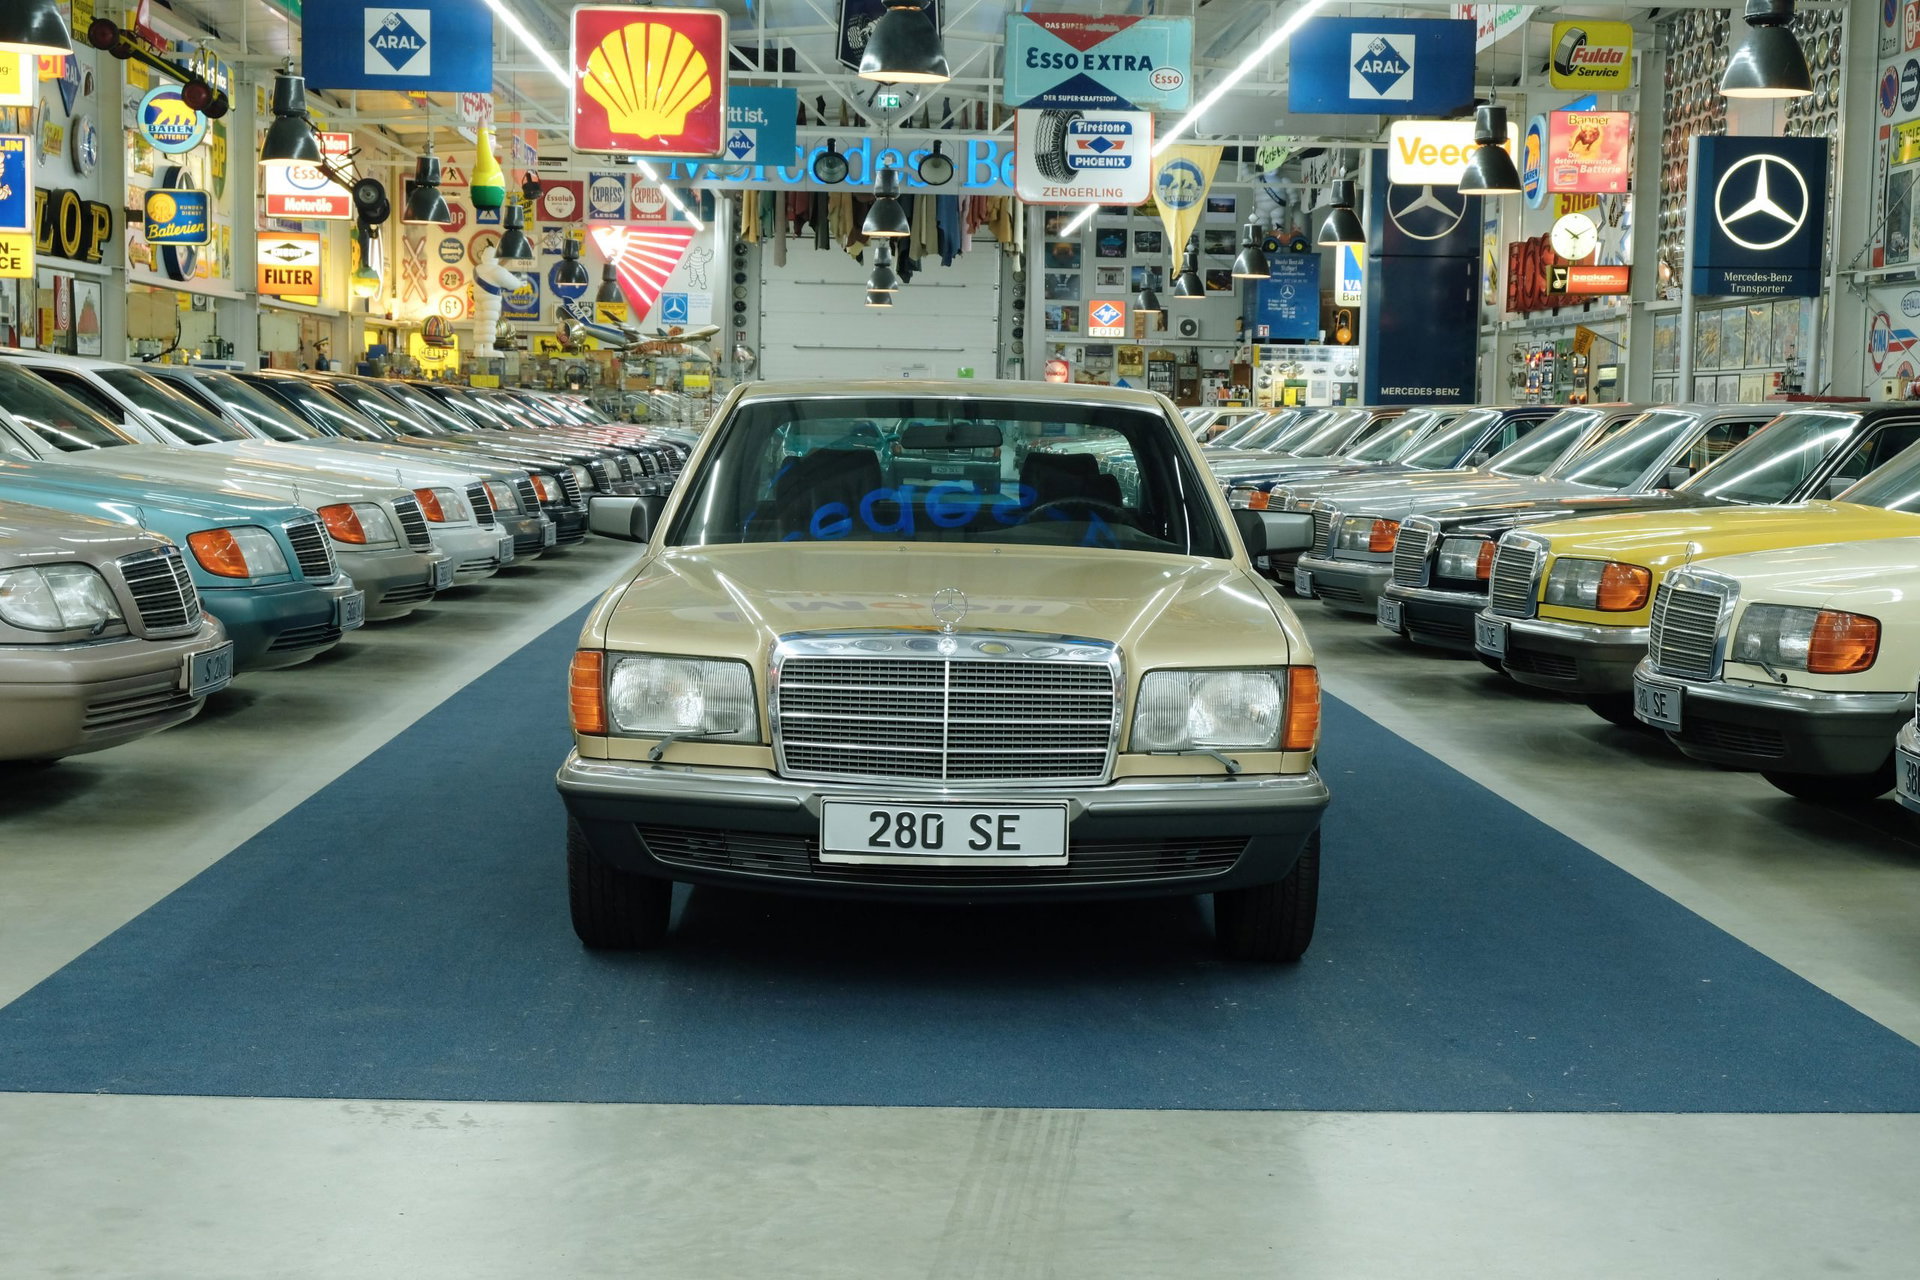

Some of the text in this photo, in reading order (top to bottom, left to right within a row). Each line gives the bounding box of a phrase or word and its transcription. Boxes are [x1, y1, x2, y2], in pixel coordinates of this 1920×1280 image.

[376, 35, 420, 50] ARAL
[1882, 37, 1896, 51] Zone
[1572, 47, 1624, 64] Fulda
[1084, 54, 1153, 72] EXTRA
[1361, 60, 1404, 74] ARAL
[1155, 74, 1180, 84] Esso
[1577, 67, 1619, 77] Service
[1043, 94, 1117, 103] DER SUPER-KRAFTSTOFF
[727, 107, 768, 126] itt ist,
[1568, 114, 1610, 125] Banner
[1075, 121, 1126, 133] Firestone
[728, 141, 752, 149] ARAL
[1075, 157, 1126, 168] PHOENIX
[1580, 165, 1621, 174] Batterie
[546, 194, 573, 202] Essolub
[592, 186, 622, 203] EXPRESS
[634, 187, 664, 204] EXPRESS
[1042, 187, 1123, 198] ZENGERLING
[1875, 143, 1887, 244] MOTANOL
[284, 197, 333, 213] Motoröle
[450, 211, 464, 225] OP
[147, 220, 205, 239] Batterien
[265, 269, 313, 285] FILTER
[1724, 272, 1793, 283] Mercedes-Benz
[1731, 284, 1785, 295] Transporter
[566, 302, 584, 320] ANA
[1092, 328, 1121, 336] FOTO
[1381, 387, 1460, 396] MERCEDES-BENZ
[1487, 626, 1496, 647] SE
[1653, 692, 1668, 719] SE
[868, 810, 1021, 851] 280 SE
